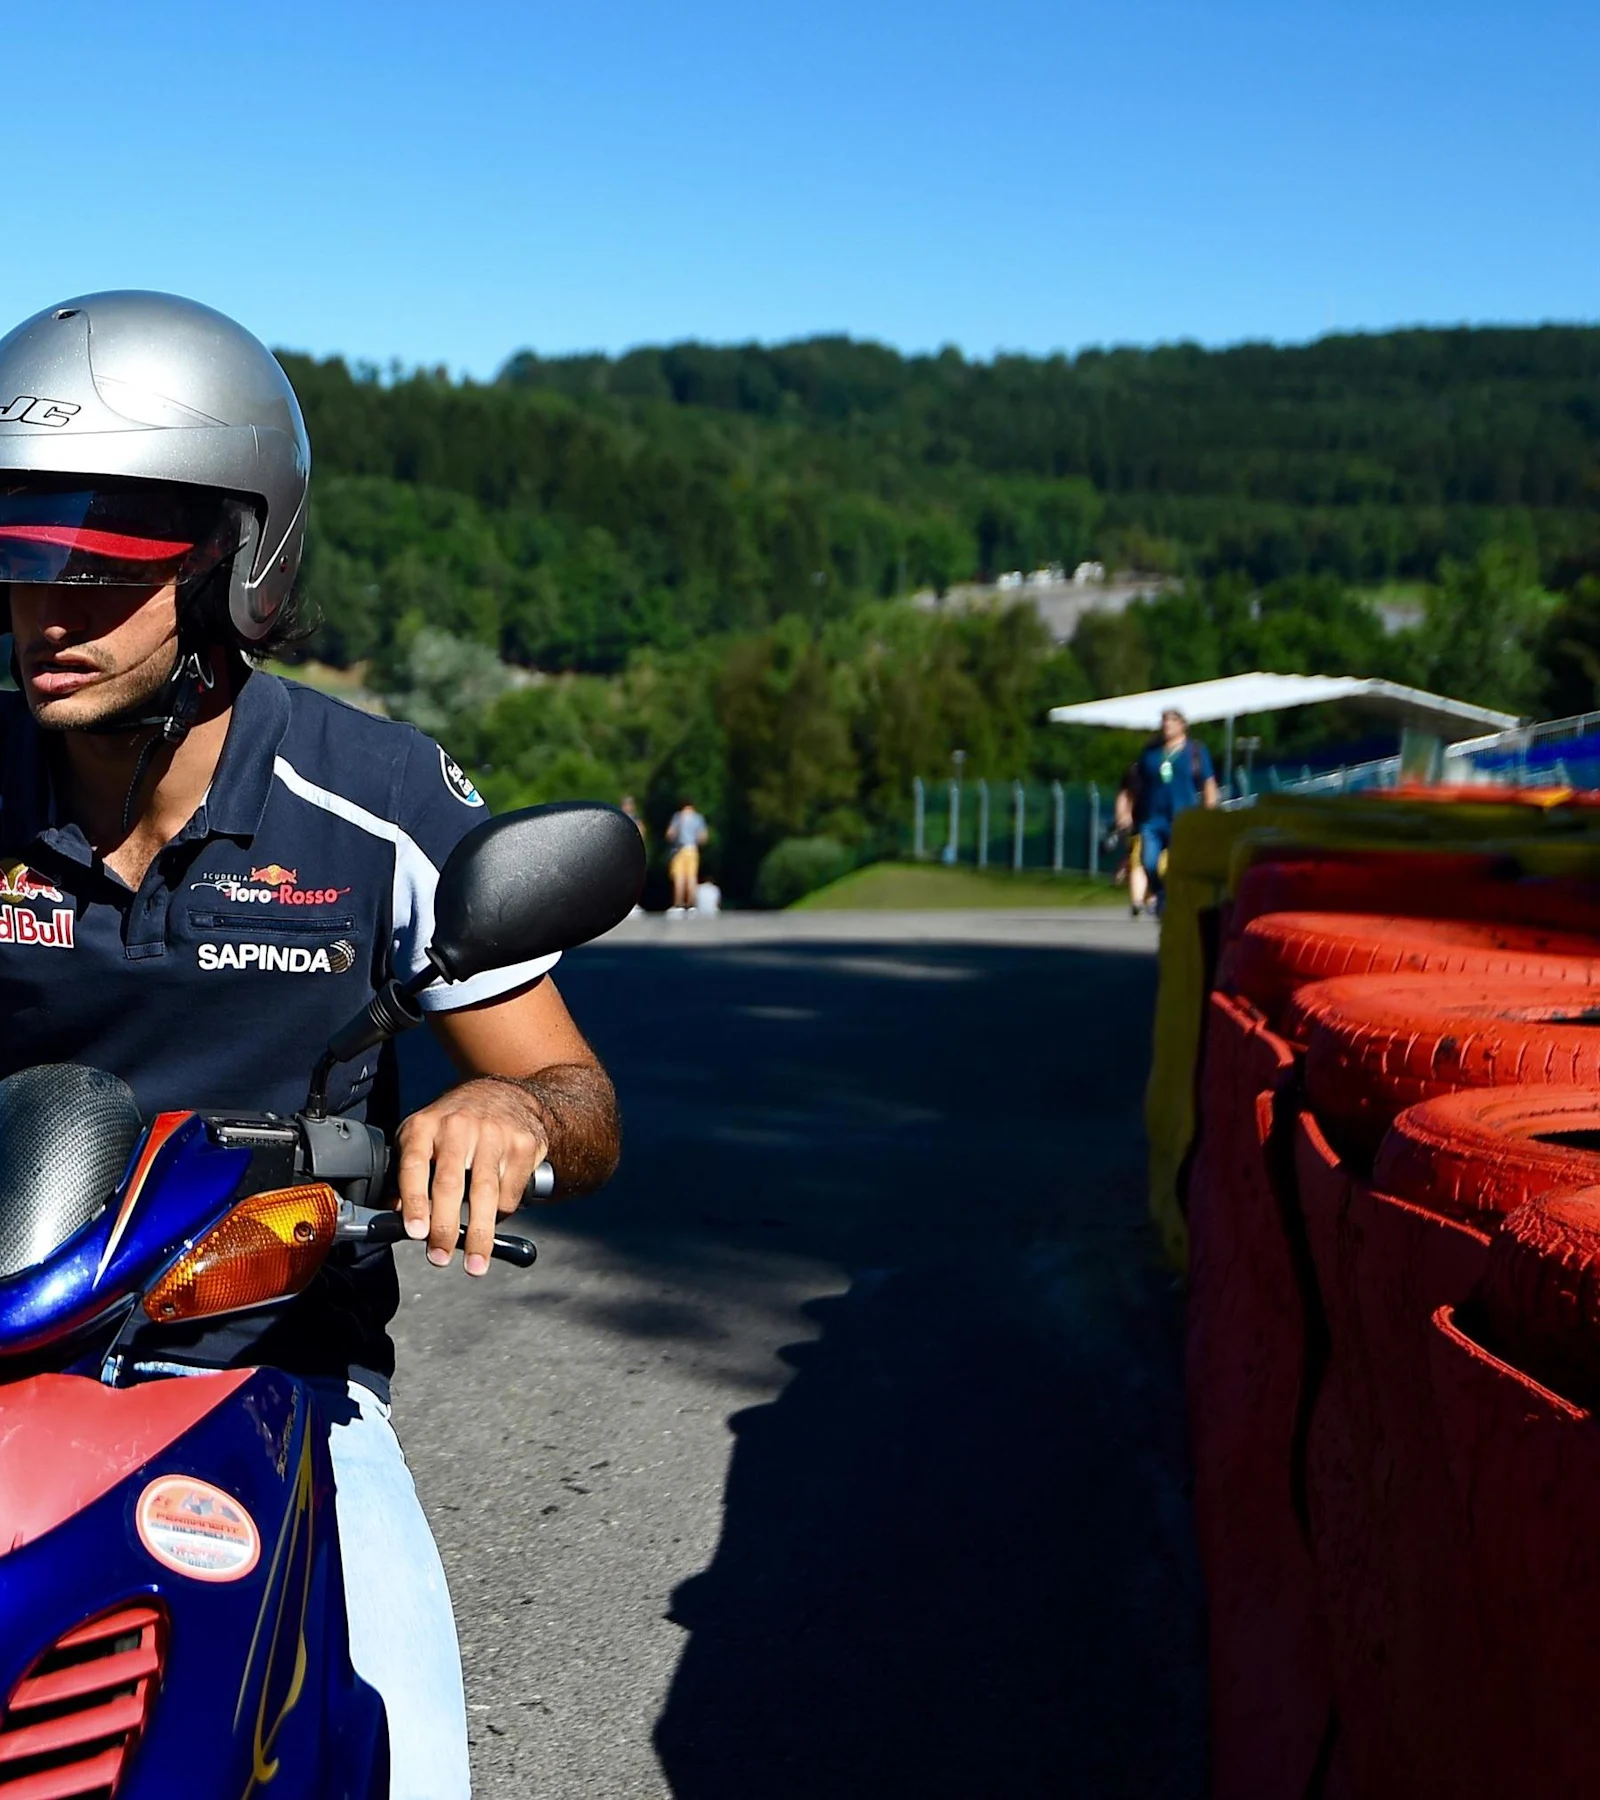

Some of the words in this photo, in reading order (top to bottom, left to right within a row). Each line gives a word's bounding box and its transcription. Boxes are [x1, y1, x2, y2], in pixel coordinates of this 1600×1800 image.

[203, 872, 249, 882] SCUDERIA
[228, 881, 273, 904] Toro
[279, 884, 338, 905] Rosso
[197, 943, 332, 974] SAPINDA
